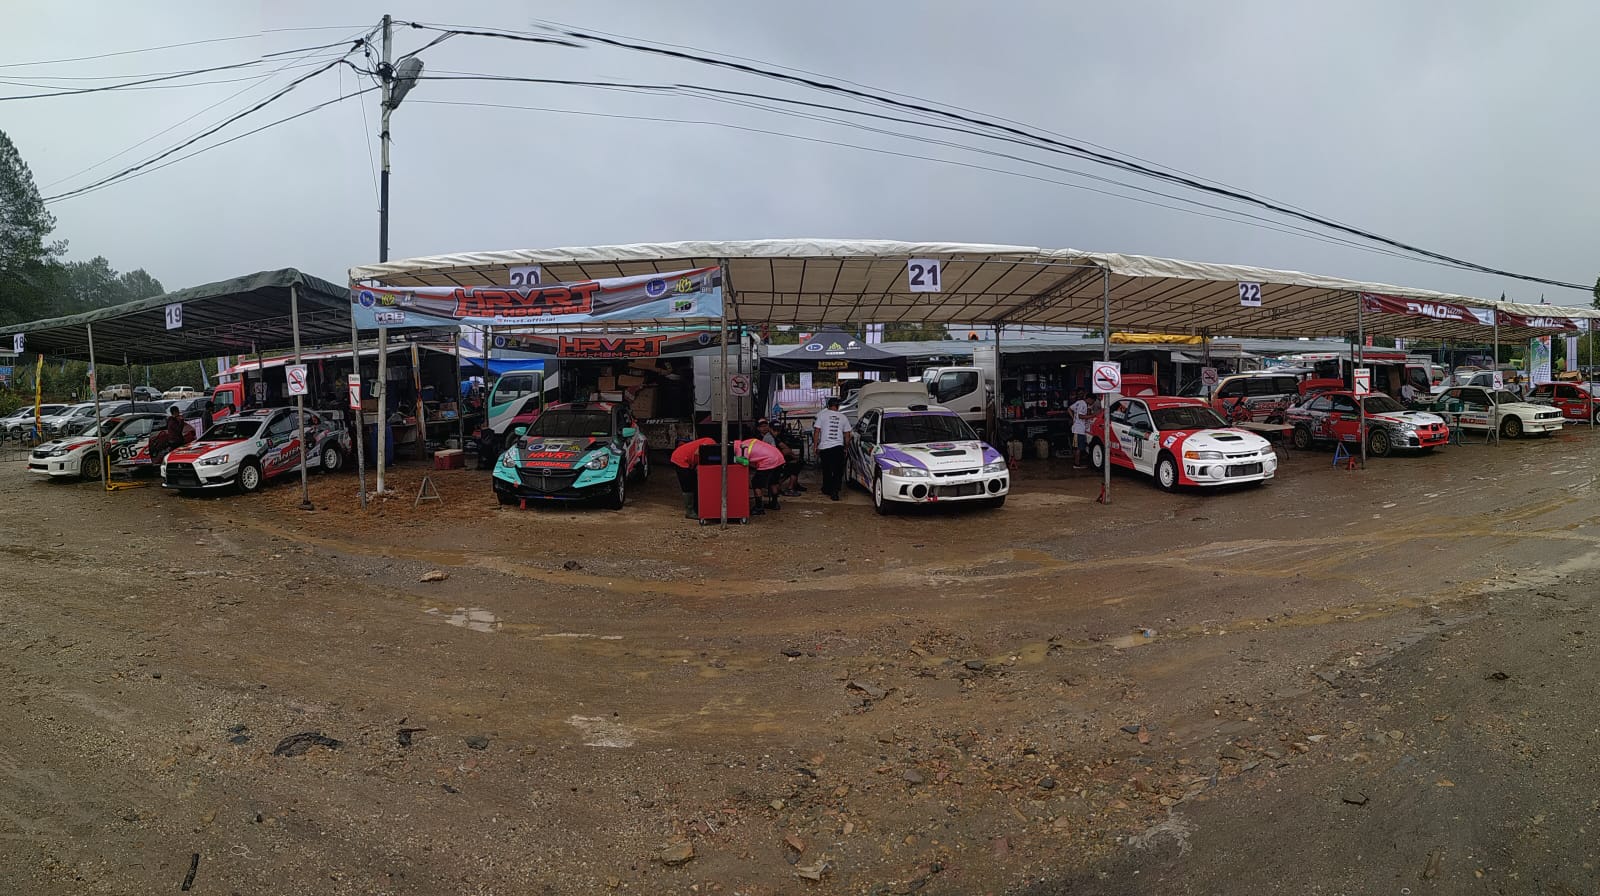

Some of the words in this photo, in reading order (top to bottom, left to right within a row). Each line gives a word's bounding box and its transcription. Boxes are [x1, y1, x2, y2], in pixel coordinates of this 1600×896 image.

[511, 271, 540, 286] 20
[909, 263, 939, 286] 21
[455, 283, 599, 309] HRVRT
[1239, 284, 1261, 302] 22
[166, 306, 182, 325] 19
[14, 336, 25, 350] 18
[558, 335, 668, 352] HRVRT
[119, 444, 138, 459] 86
[1133, 436, 1143, 458] 20
[1186, 464, 1196, 476] 20
